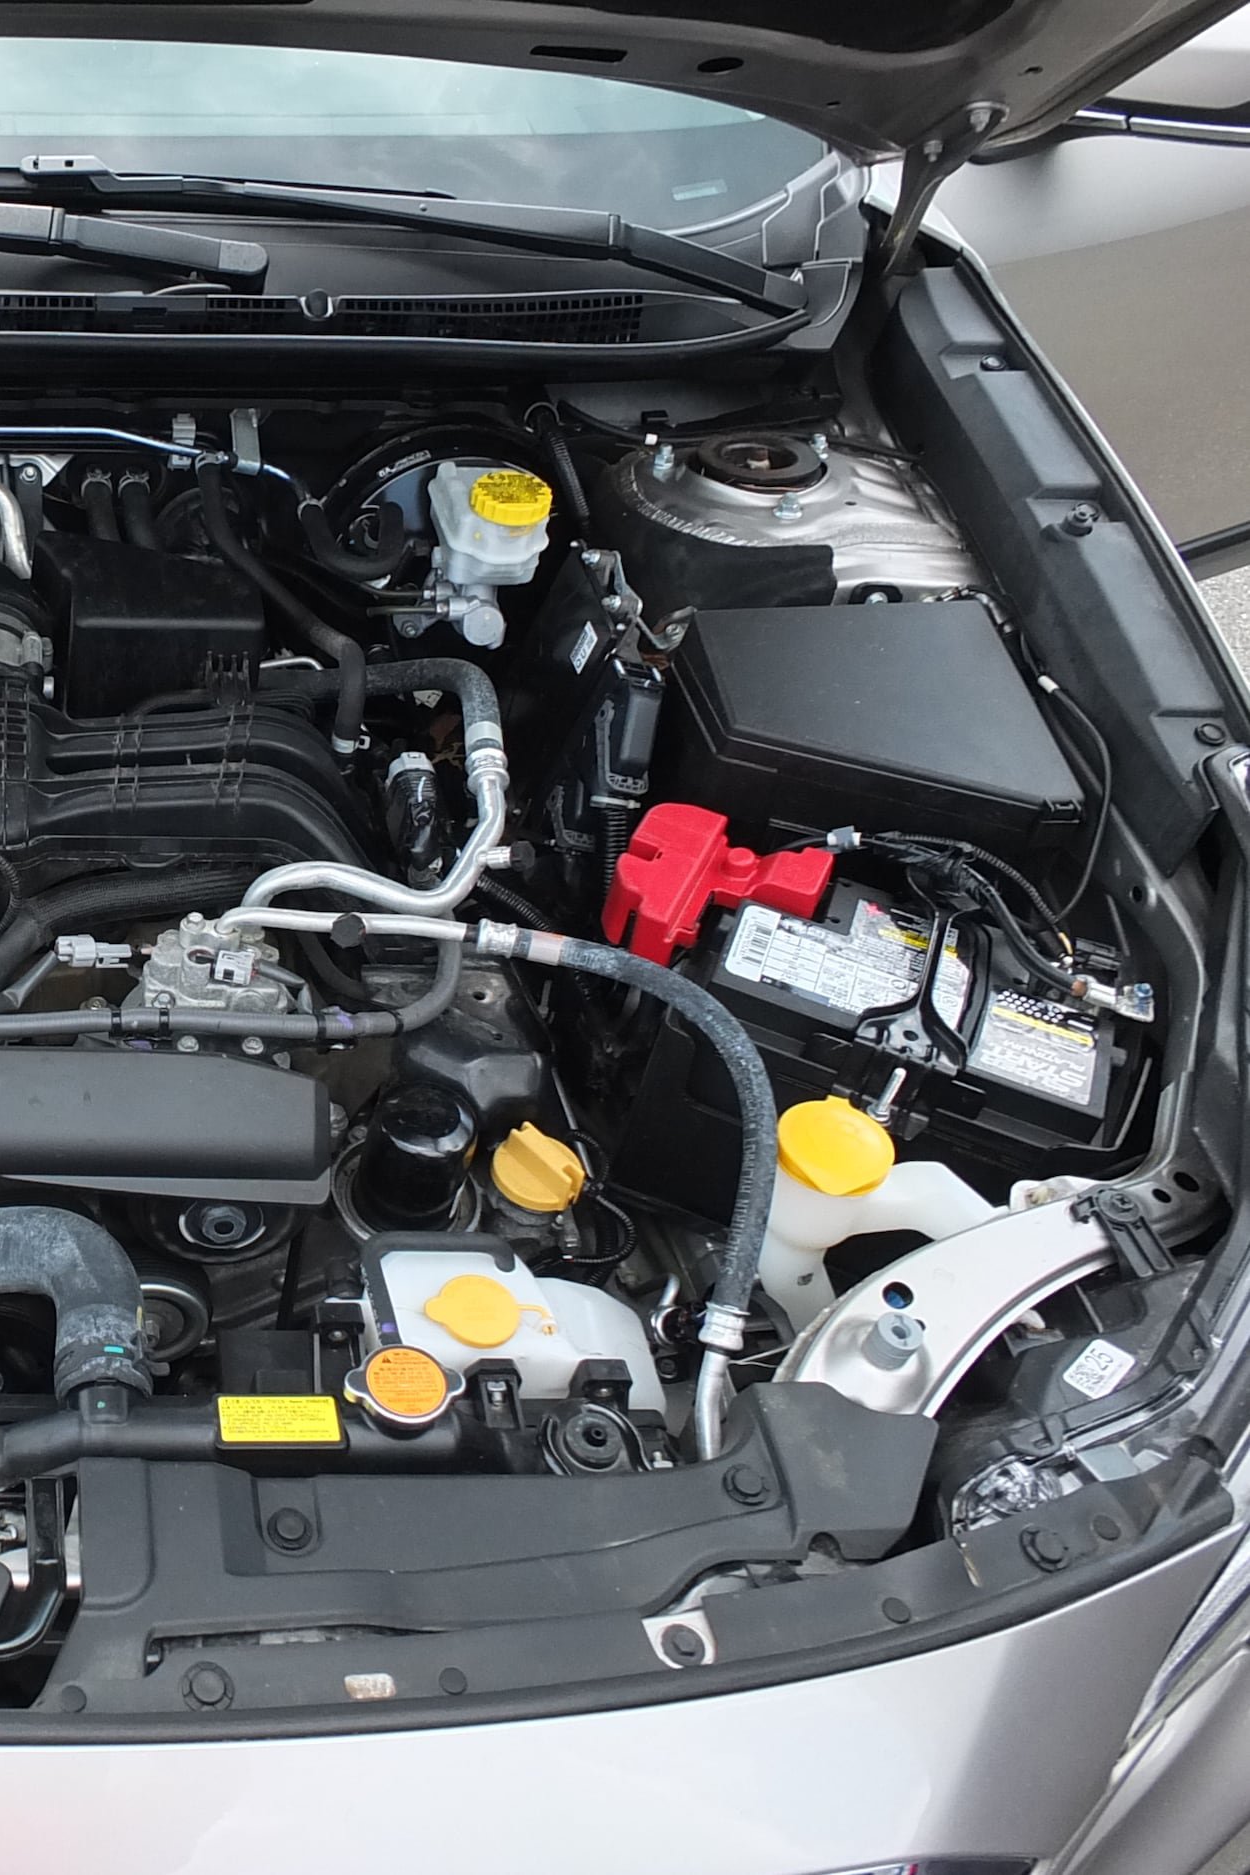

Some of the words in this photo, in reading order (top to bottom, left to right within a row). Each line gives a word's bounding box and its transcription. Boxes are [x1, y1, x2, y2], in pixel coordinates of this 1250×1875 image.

[980, 1054, 1071, 1092] SUPER
[982, 1045, 1087, 1088] START
[1003, 1040, 1086, 1072] PLATINUM
[1084, 1347, 1114, 1371] 25
